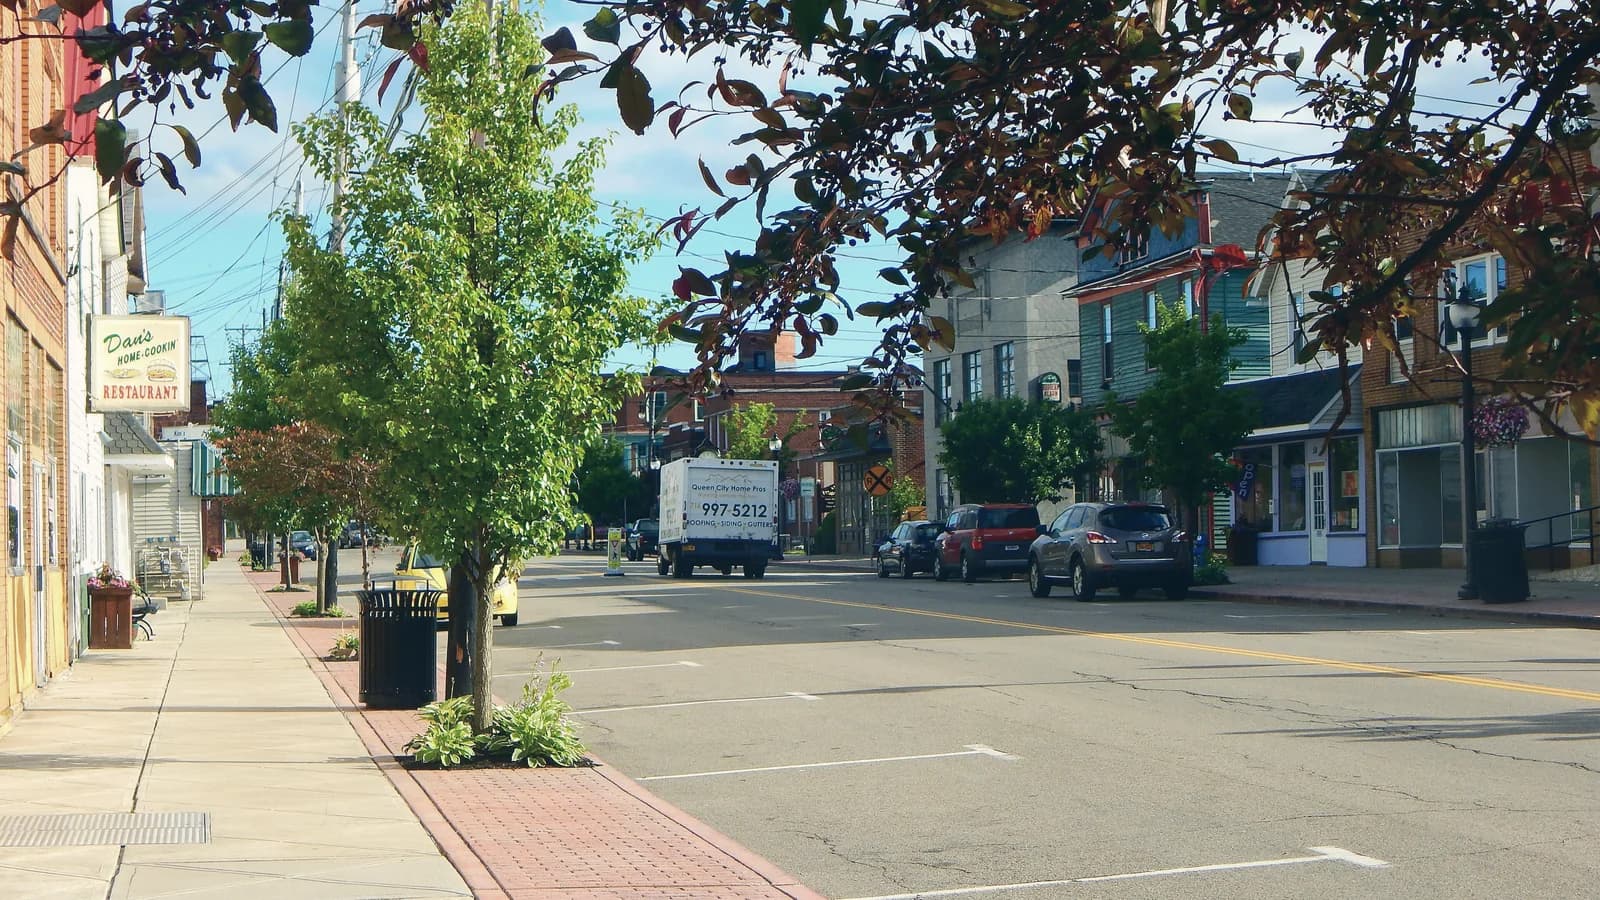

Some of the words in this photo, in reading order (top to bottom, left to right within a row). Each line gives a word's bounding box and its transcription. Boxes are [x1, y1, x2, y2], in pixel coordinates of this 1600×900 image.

[103, 329, 154, 353] Dan's
[103, 385, 178, 400] RESTAURANT
[716, 484, 730, 493] City
